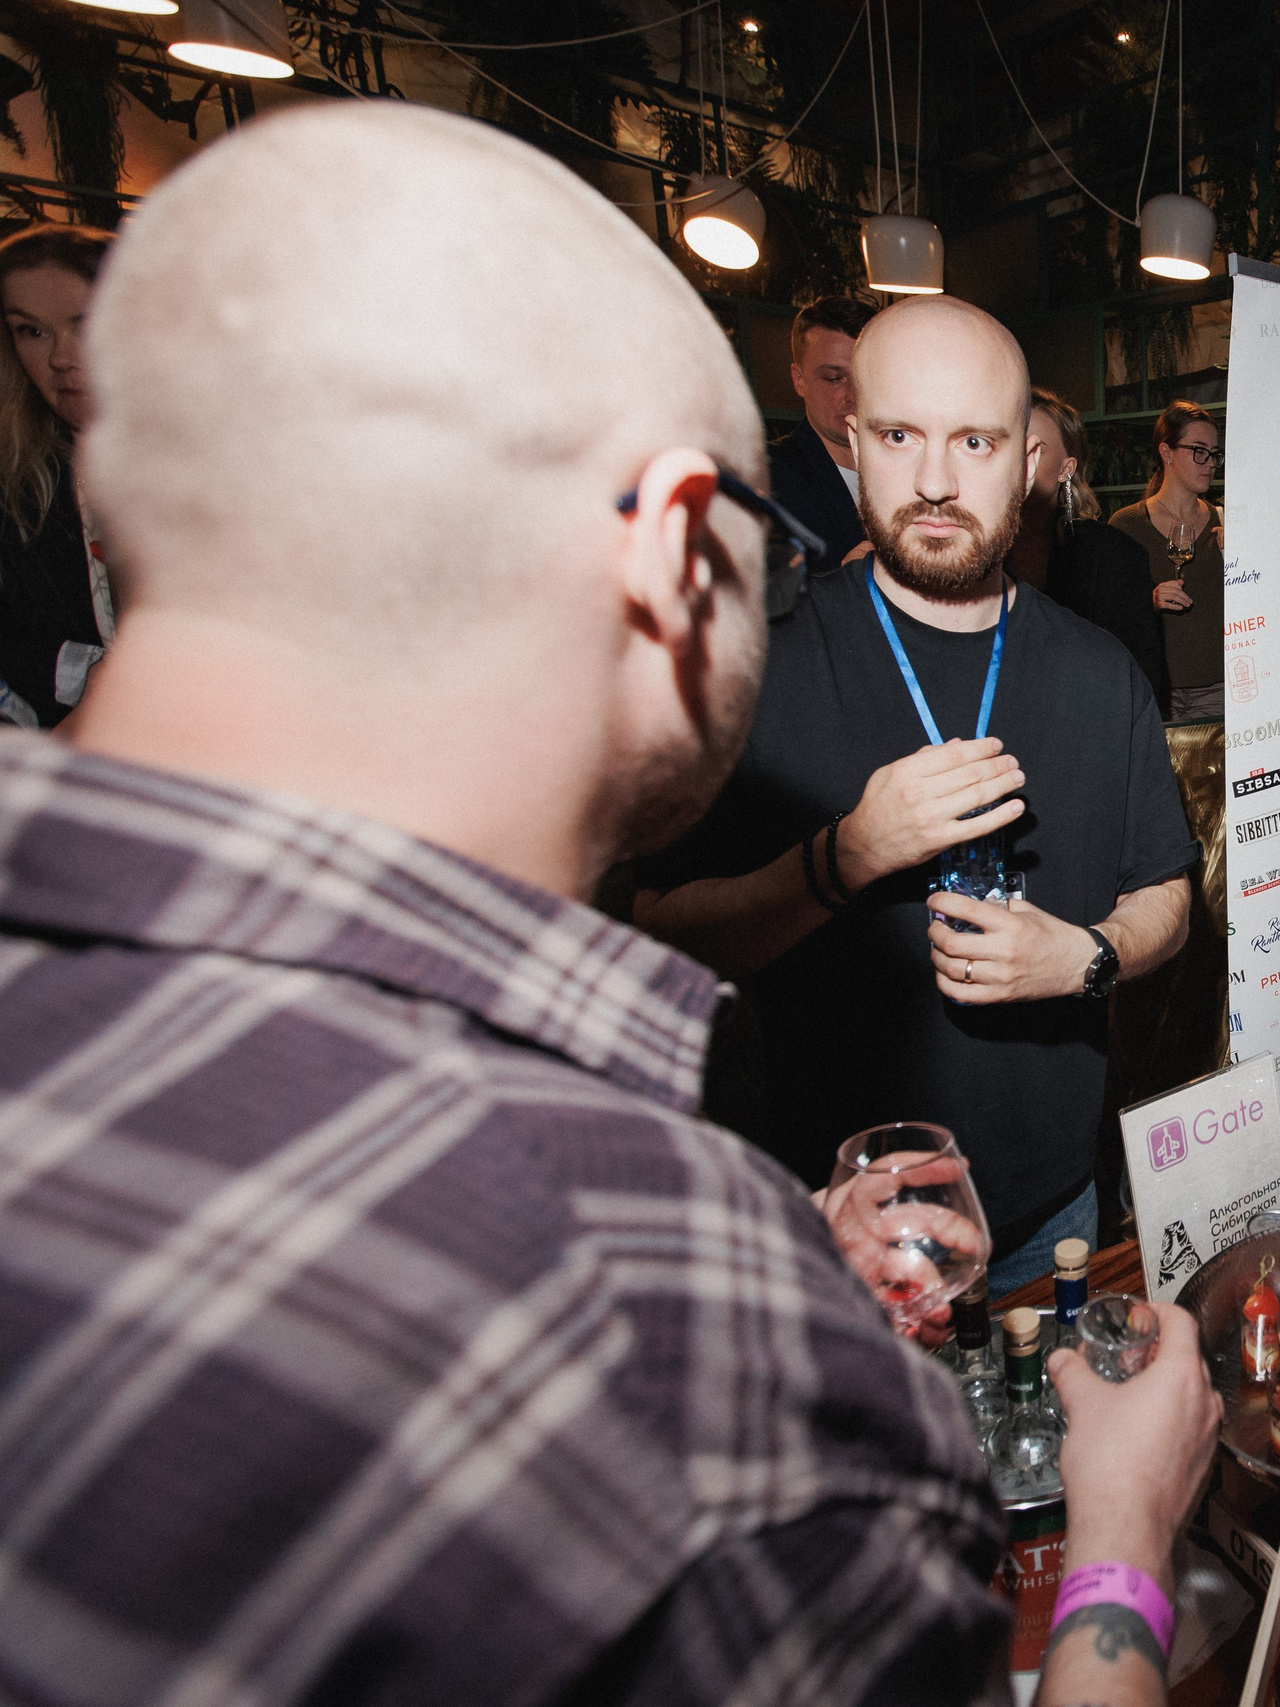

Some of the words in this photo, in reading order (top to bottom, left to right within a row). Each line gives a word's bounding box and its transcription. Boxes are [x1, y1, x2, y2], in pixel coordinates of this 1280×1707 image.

[1236, 773, 1280, 794] SIBSA
[1240, 875, 1265, 891] SEA
[1192, 1099, 1264, 1145] Gate
